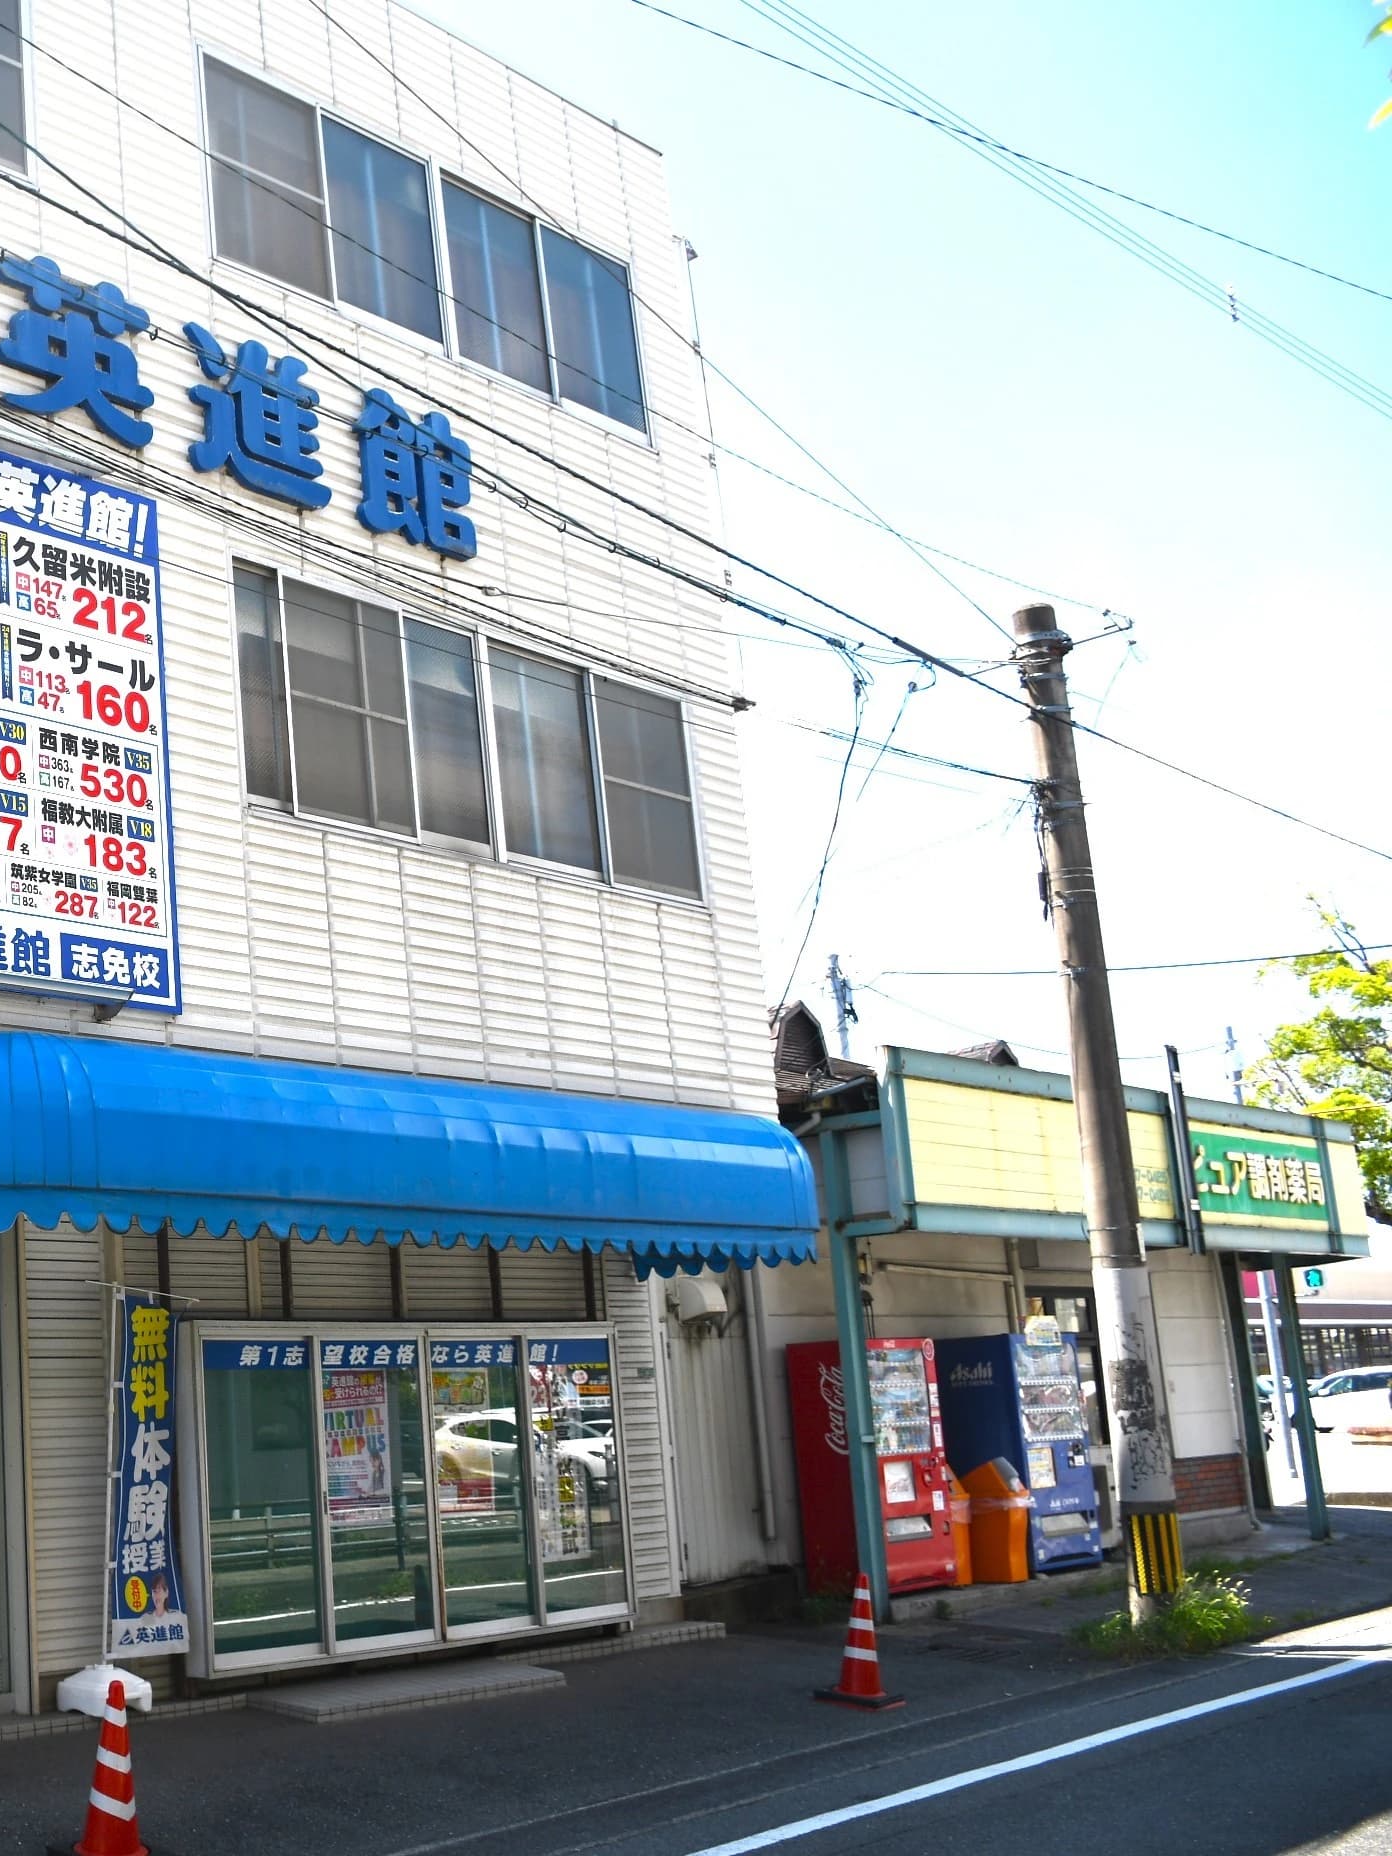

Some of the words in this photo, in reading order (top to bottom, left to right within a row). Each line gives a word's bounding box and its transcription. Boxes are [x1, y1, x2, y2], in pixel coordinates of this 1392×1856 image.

[12, 536, 151, 604] 久留米附設
[73, 588, 153, 645] 212名
[17, 628, 155, 691] ラ・サール
[77, 681, 157, 735] 160名
[0, 721, 25, 741] V30
[39, 727, 121, 766] 西南学院
[126, 751, 149, 771] V35
[0, 792, 26, 812] V15
[80, 764, 154, 811] 530名
[41, 798, 124, 836] 福教大附属
[129, 820, 153, 839] V18
[10, 863, 77, 889] 筑紫女学園
[84, 834, 158, 879] 183名
[107, 881, 159, 904] 福岡雙葉
[70, 943, 161, 989] 志免校
[950, 1361, 994, 1381] Asahi
[325, 1433, 386, 1458] AMPUS
[130, 1578, 142, 1611] 受付中
[135, 1623, 184, 1644] 英進館
